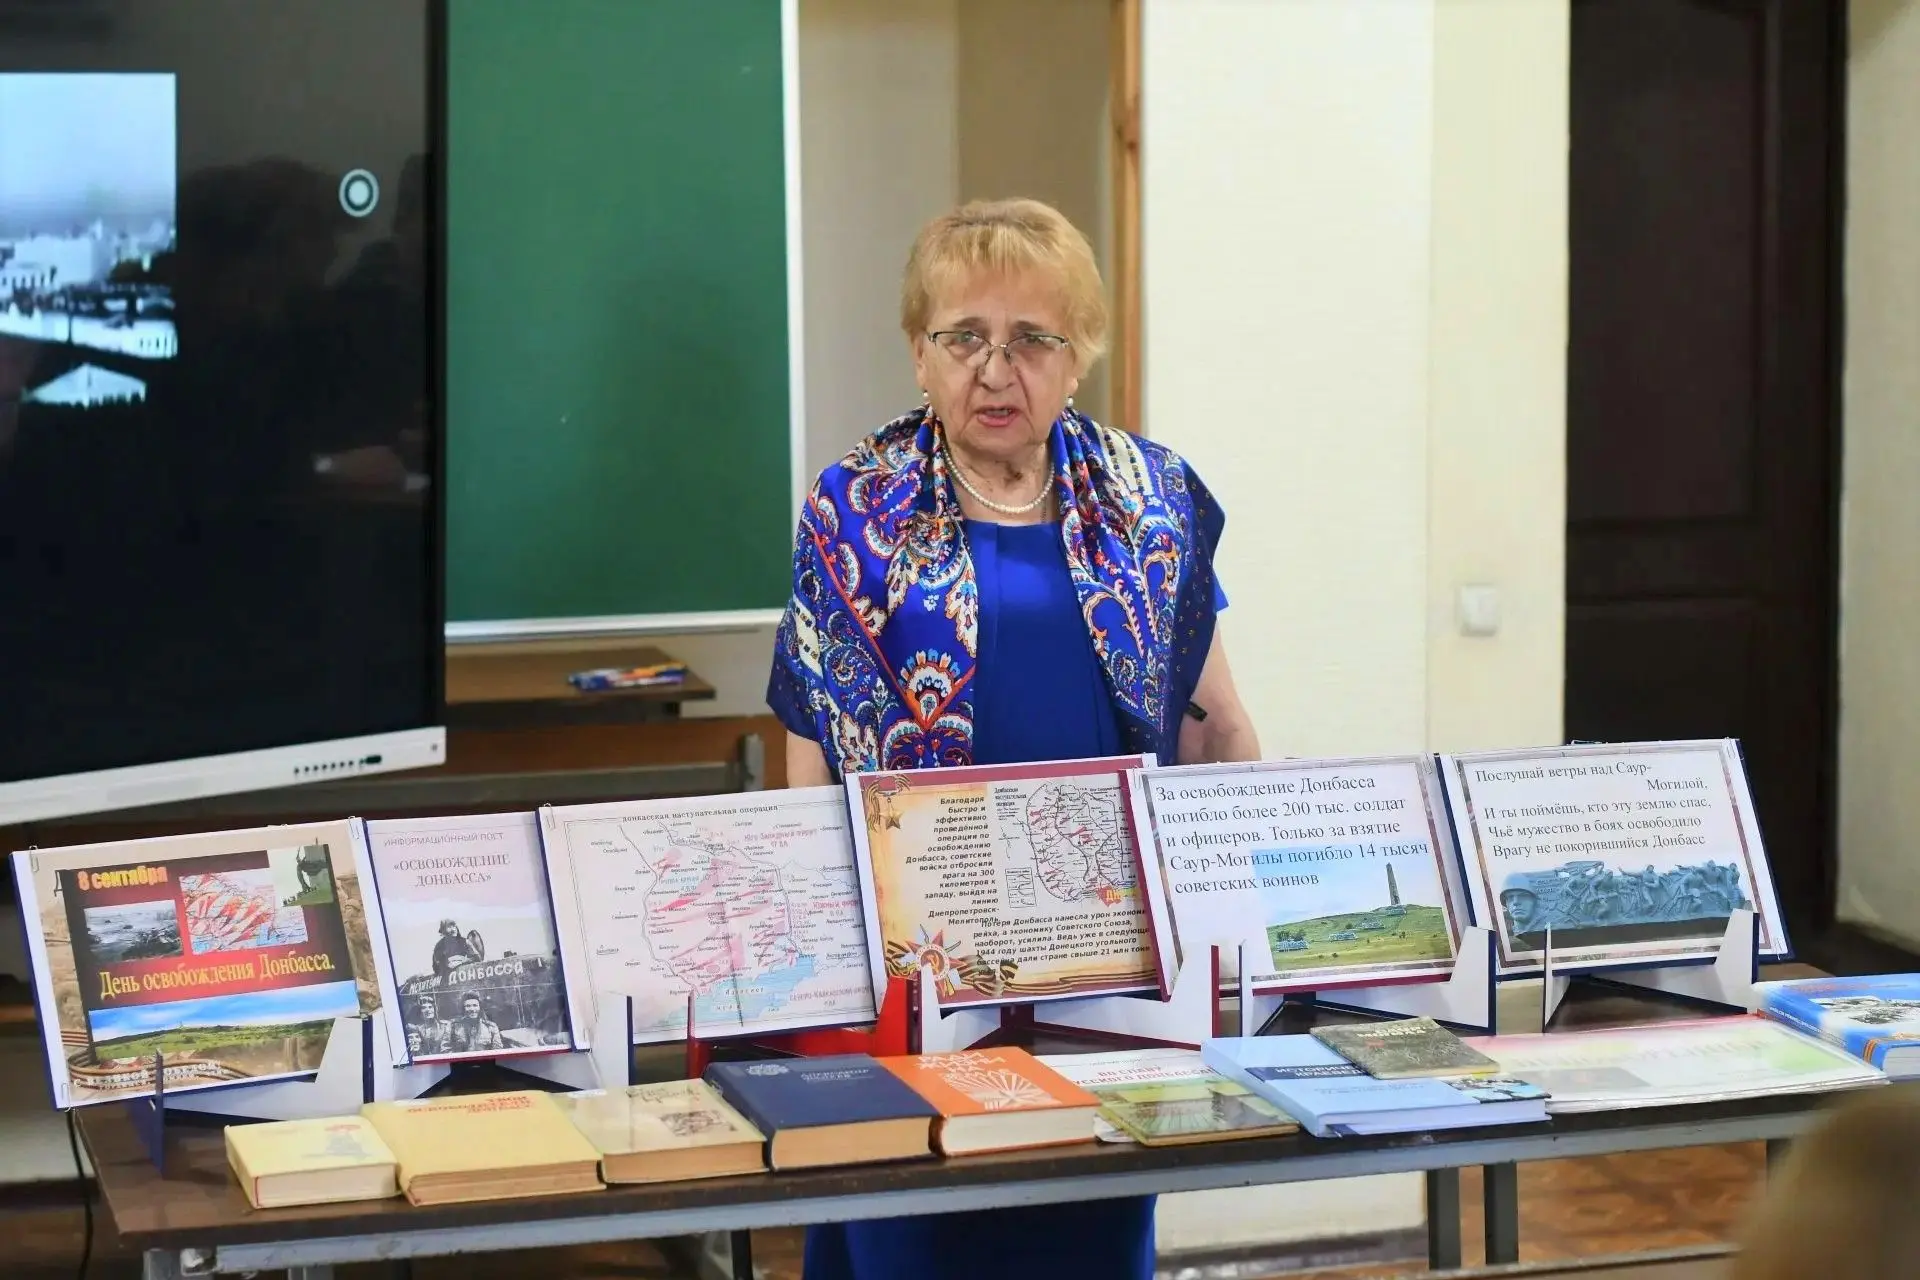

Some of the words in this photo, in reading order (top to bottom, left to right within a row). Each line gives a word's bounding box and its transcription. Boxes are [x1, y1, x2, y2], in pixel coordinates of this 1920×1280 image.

[1475, 766, 1544, 783] Послушай
[1548, 766, 1587, 780] ветры
[1590, 765, 1613, 775] над
[1616, 761, 1652, 776] Саур-
[1155, 786, 1176, 801] За
[1180, 783, 1295, 800] освобождение
[1300, 775, 1376, 795] Донбасса
[940, 796, 985, 805] Благодаря
[739, 804, 778, 815] операция
[948, 806, 978, 814] быстро
[1162, 807, 1228, 824] погибло
[1232, 805, 1278, 820] более
[1281, 801, 1310, 817] 200
[1314, 803, 1350, 815] тыс.
[1353, 798, 1406, 813] солдат
[1484, 807, 1496, 819] И
[1499, 808, 1518, 818] ты
[1520, 802, 1585, 817] поймёшь,
[1587, 803, 1609, 813] кто
[1611, 801, 1633, 814] эту
[1635, 800, 1677, 811] землю
[1679, 798, 1712, 809] спас,
[935, 814, 987, 825] эффективно
[1488, 825, 1514, 838] Чьё
[1517, 824, 1580, 838] мужество
[1583, 823, 1592, 832] в
[1594, 818, 1624, 832] боях
[1627, 816, 1702, 830] освободило
[383, 832, 479, 847] ИНФОРМАЦИОННЫЙ
[480, 832, 504, 841] ПОСТ
[937, 834, 977, 842] операции
[1166, 836, 1176, 847] и
[1181, 831, 1265, 849] офицеров.
[1269, 825, 1324, 841] Только
[1329, 825, 1346, 837] за
[1349, 821, 1401, 836] взятие
[927, 842, 991, 852] освобождению
[1493, 844, 1531, 860] Врагу
[1536, 844, 1554, 854] не
[1555, 836, 1649, 854] покорившийся
[1652, 833, 1706, 848] Донбасс
[393, 853, 511, 871] «ОСВОБОЖДЕНИЕ
[905, 854, 948, 864] Донбасса,
[950, 851, 992, 860] советские
[1170, 851, 1283, 873] Саур-Могилы
[1288, 845, 1353, 863] погибло
[1359, 843, 1376, 858] 14
[1380, 842, 1429, 857] тысяч
[949, 861, 993, 870] отбросили
[77, 870, 90, 890] 8
[91, 865, 169, 889] сентября
[415, 872, 492, 887] ДОНБАССА»
[942, 872, 966, 880] врага
[979, 869, 995, 877] 300
[939, 880, 989, 888] километров
[1175, 877, 1258, 894] советских
[1262, 874, 1320, 888] воинов
[924, 891, 956, 899] западу,
[958, 889, 985, 897] выйдя
[928, 906, 1000, 918] Днепропетровск-
[1013, 916, 1053, 926] Донбасса
[1054, 913, 1088, 922] нанесла
[1090, 911, 1111, 920] урон
[973, 930, 1000, 939] рейха,
[1009, 925, 1054, 935] экономику
[1056, 921, 1102, 931] Советского
[1104, 919, 1133, 927] Союза,
[974, 938, 1015, 947] наоборот,
[1056, 933, 1078, 941] Ведь
[1079, 932, 1097, 940] уже
[976, 949, 996, 957] 1944
[998, 948, 1017, 956] году
[1019, 944, 1047, 953] шахты
[1048, 940, 1094, 951] Донецкого
[1096, 937, 1137, 949] угольного
[1017, 955, 1038, 963] дали
[1040, 953, 1068, 962] стране
[1070, 950, 1099, 958] свыше
[99, 971, 140, 1000] День
[143, 962, 255, 991] освобождения
[259, 950, 336, 983] Донбасса.
